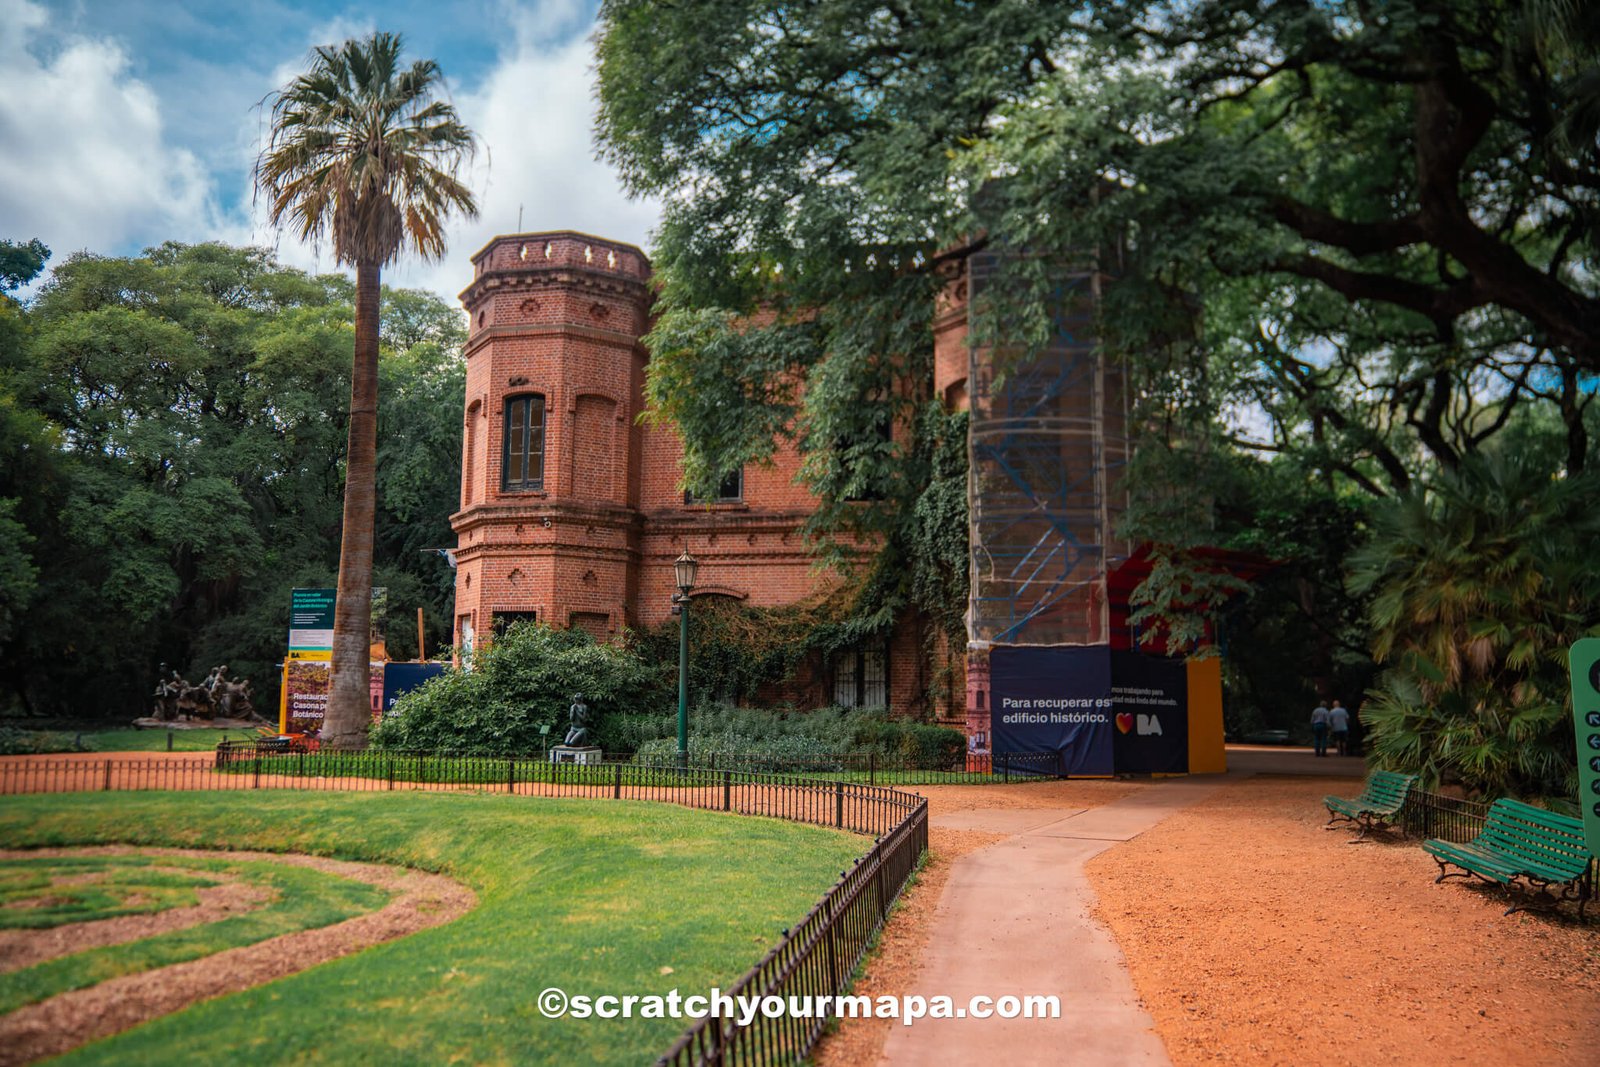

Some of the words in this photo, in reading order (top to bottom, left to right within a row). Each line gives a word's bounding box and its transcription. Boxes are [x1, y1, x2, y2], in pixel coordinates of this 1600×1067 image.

[1002, 698, 1031, 708] Para
[1033, 699, 1093, 710] recuperar
[1002, 713, 1048, 723] edificio
[1050, 712, 1109, 723] histórico.
